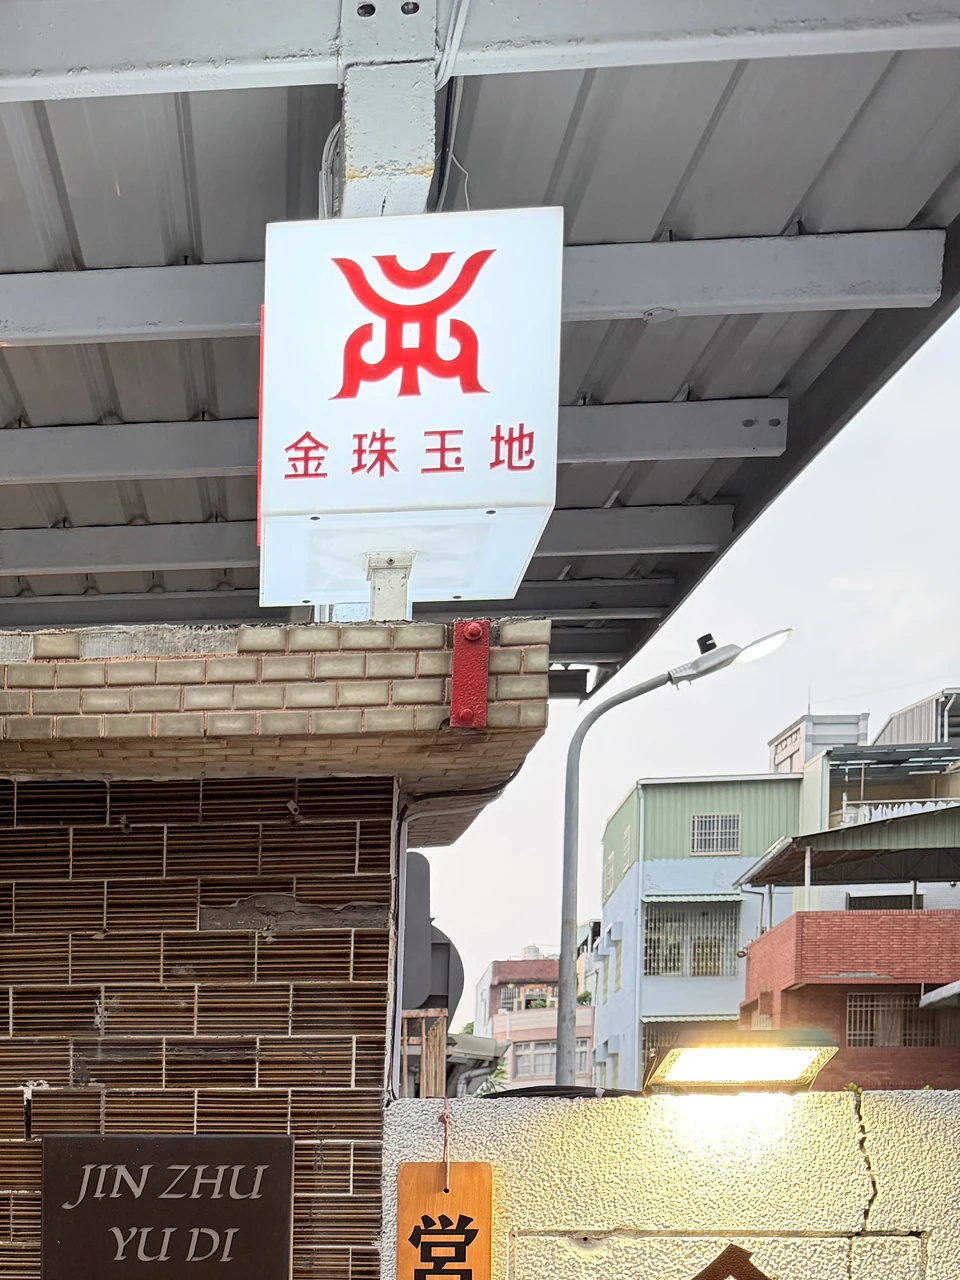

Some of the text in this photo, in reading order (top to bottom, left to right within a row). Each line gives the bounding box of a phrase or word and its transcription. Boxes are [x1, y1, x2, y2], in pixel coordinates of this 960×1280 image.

[283, 423, 536, 480] 金珠玉地
[61, 1164, 270, 1210] JIN ZHU
[108, 1226, 240, 1262] YU DI
